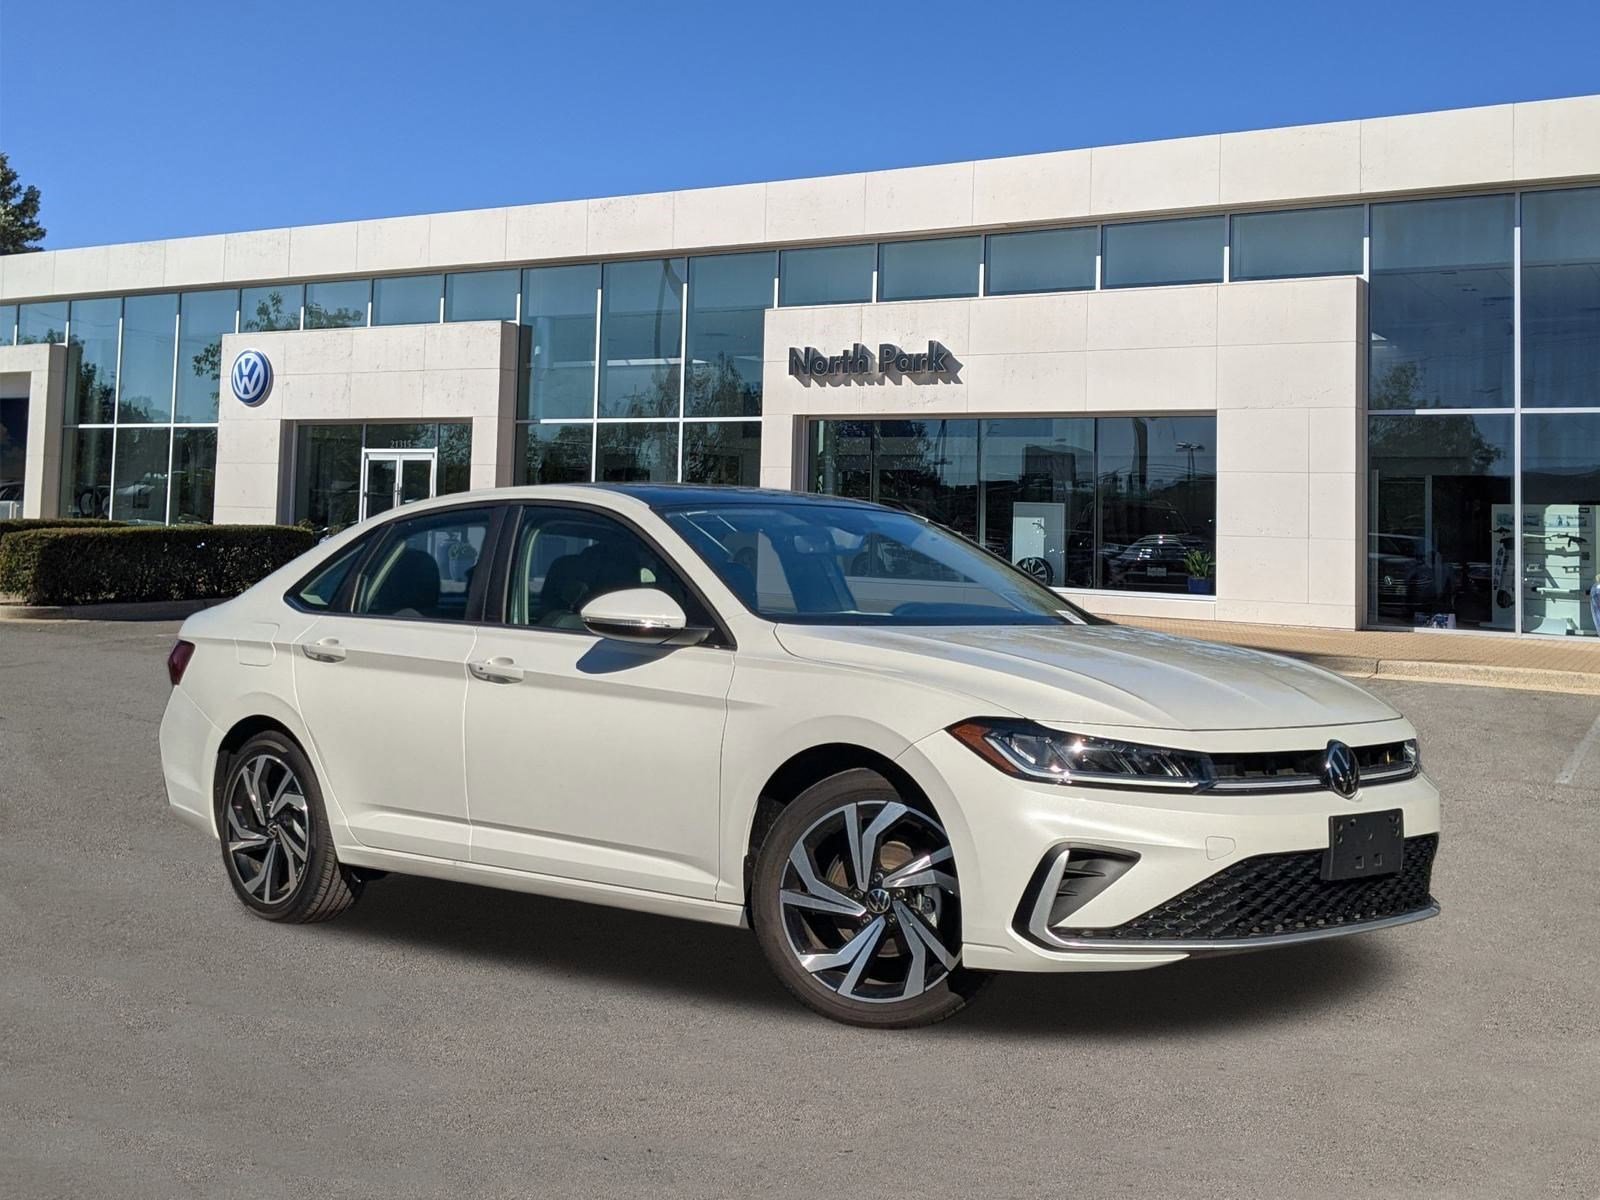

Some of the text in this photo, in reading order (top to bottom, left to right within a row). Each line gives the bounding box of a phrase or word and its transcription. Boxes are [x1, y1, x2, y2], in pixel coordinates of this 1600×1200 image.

[232, 352, 265, 400] VW
[788, 339, 949, 376] North Park
